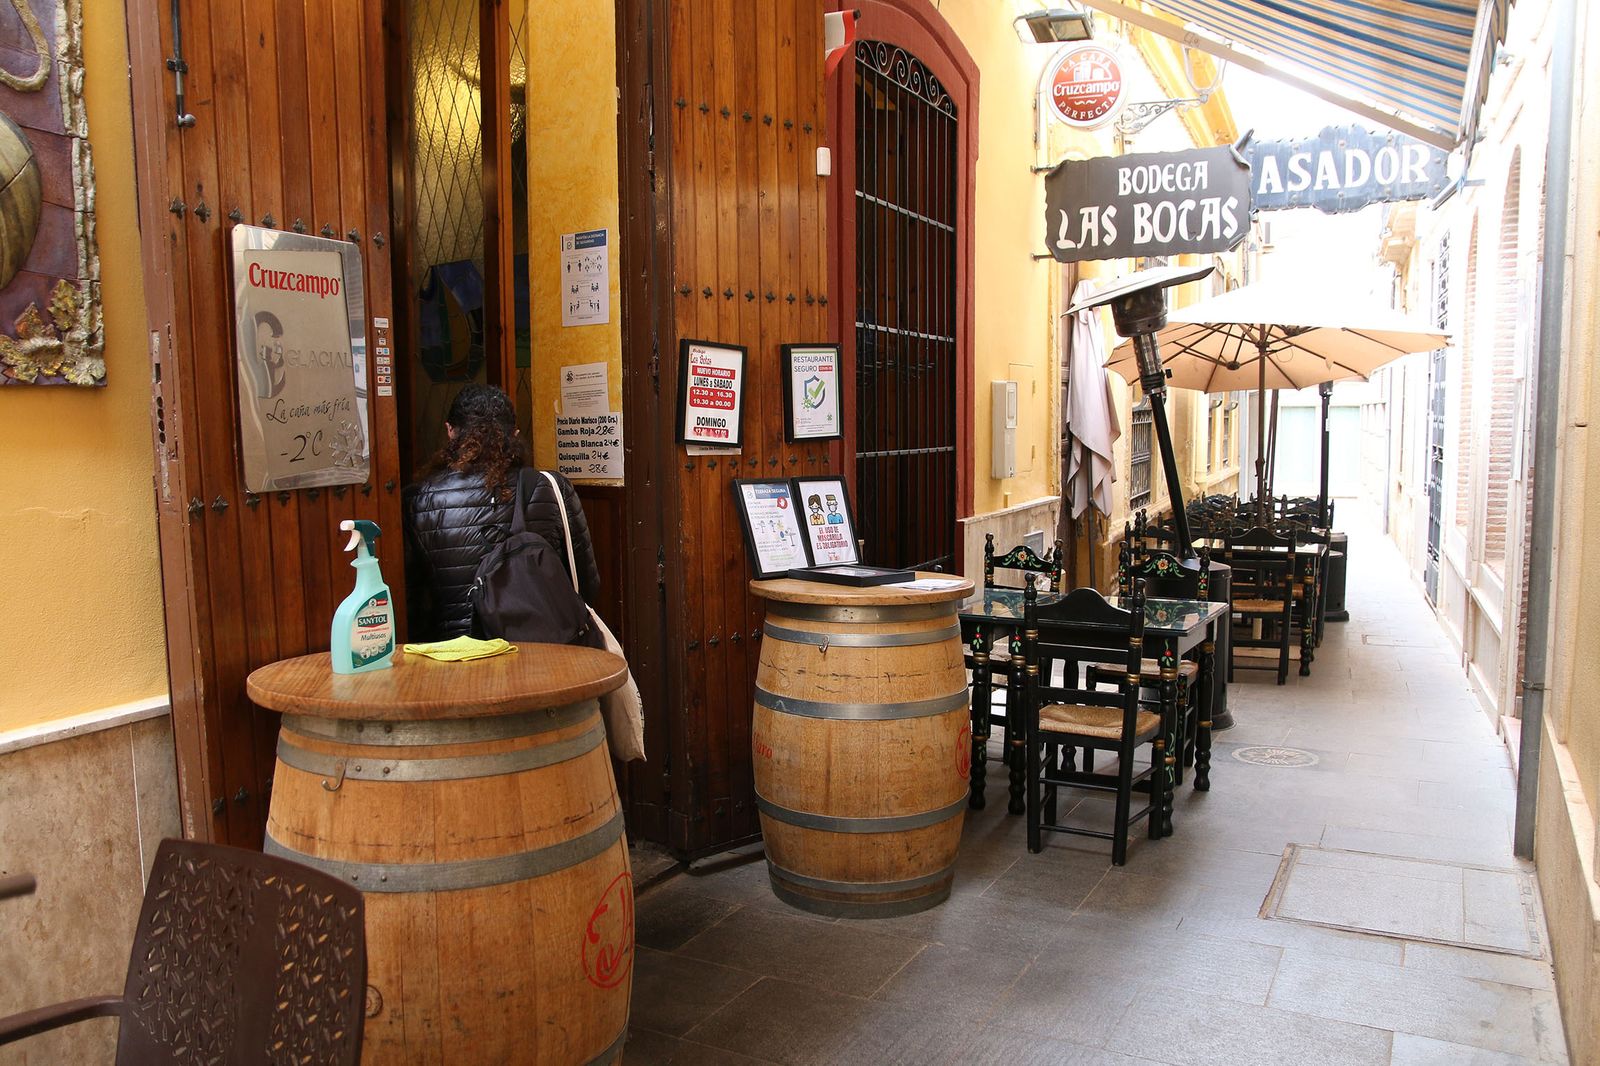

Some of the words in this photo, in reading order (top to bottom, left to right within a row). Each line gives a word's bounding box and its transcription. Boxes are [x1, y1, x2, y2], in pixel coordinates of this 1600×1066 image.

[1053, 81, 1121, 97] Cruzcampo
[1058, 96, 1117, 120] PERFECTA
[1257, 144, 1431, 194] ASADOR
[1118, 160, 1208, 196] BODEGA
[1056, 204, 1118, 249] LAS
[1133, 196, 1239, 245] BOTAS
[248, 262, 339, 299] Cruzcampo
[286, 348, 352, 368] GLACIAL
[793, 355, 833, 363] RESTAURANTE
[696, 367, 711, 375] NUEVO
[711, 368, 731, 377] HORARIO
[794, 365, 817, 373] SEGURO
[693, 377, 709, 387] LUNES
[713, 379, 733, 390] SABADO
[716, 391, 733, 399] 16.30
[266, 398, 288, 424] La
[289, 404, 310, 418] caña
[313, 400, 330, 415] más
[329, 397, 351, 421] fría
[556, 417, 569, 425] Precio
[569, 417, 580, 425] Diario
[581, 416, 598, 425] Marisco
[696, 416, 727, 428] DOMINGO
[580, 427, 595, 436] Roja
[595, 425, 615, 435] 28€
[558, 440, 579, 448] Gamba
[581, 439, 603, 448] Blanca
[603, 438, 620, 447] 24€
[559, 453, 590, 462] Quisquilla
[559, 465, 582, 474] Cigalas
[588, 463, 608, 473] 28€
[817, 533, 843, 541] MASCARILLA
[816, 542, 822, 550] ES
[822, 540, 848, 550] OBLIGATORIO
[358, 616, 387, 626] SANYTOL
[361, 632, 387, 641] Multiusos
